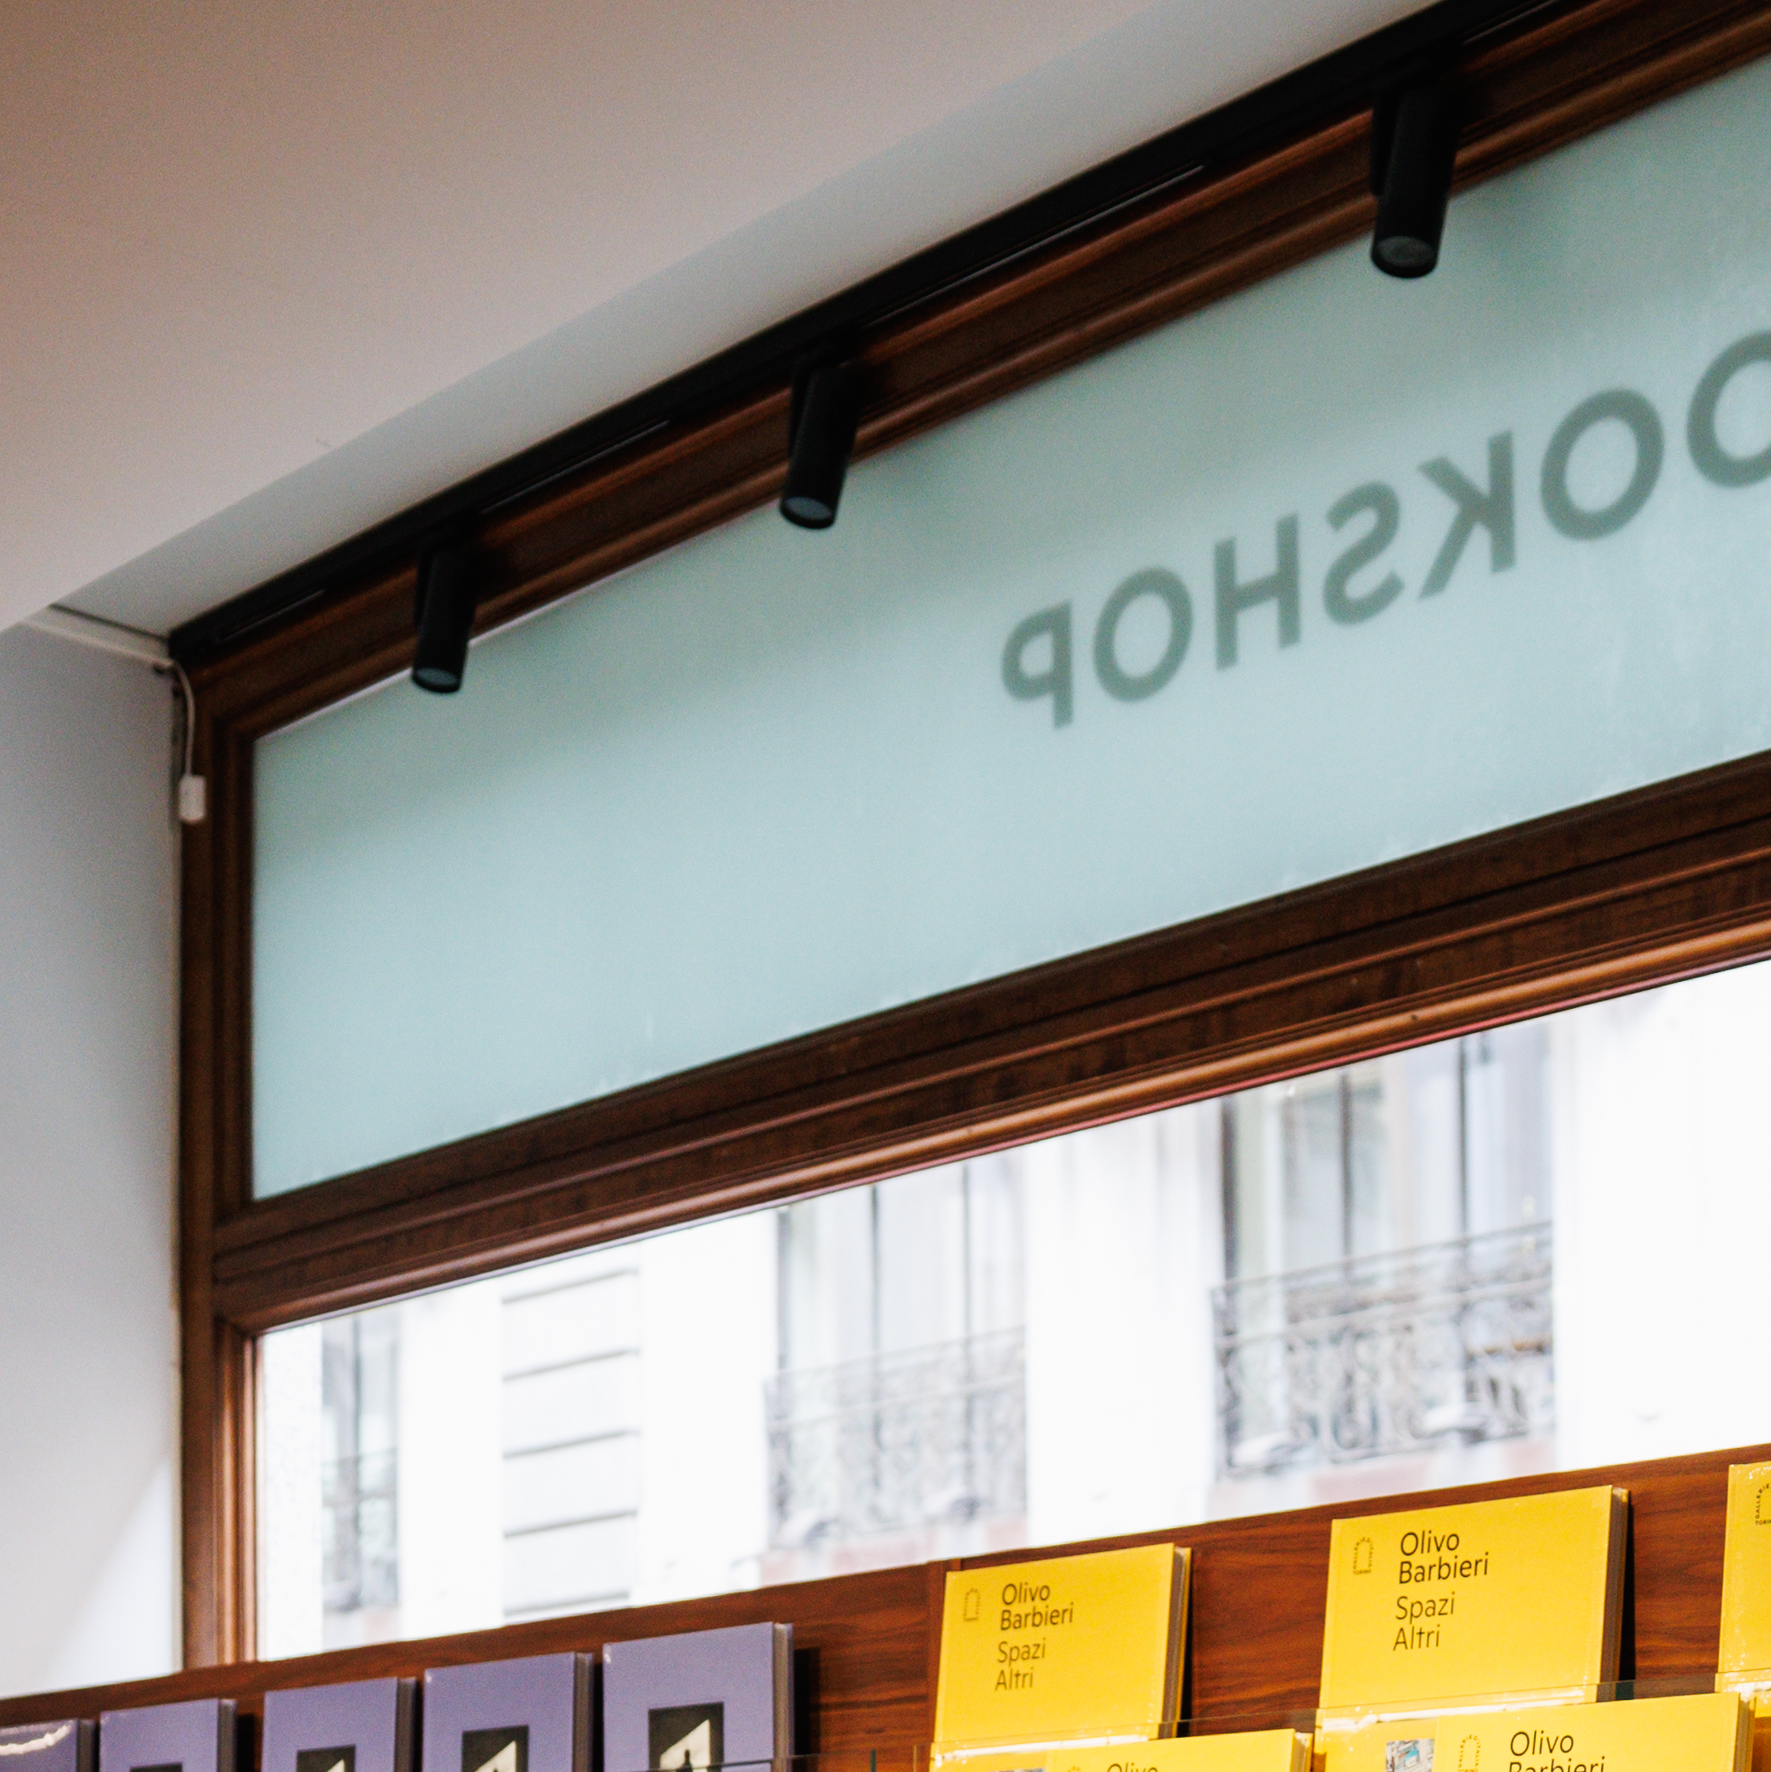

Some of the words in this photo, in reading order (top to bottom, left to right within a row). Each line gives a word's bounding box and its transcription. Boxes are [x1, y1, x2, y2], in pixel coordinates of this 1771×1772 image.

[1400, 1530, 1460, 1557] Olivo
[1398, 1556, 1489, 1585] Barbieri
[1002, 1582, 1051, 1606] Olivo
[1000, 1606, 1073, 1631] Barbieri
[1395, 1595, 1455, 1625] Spazi
[1393, 1625, 1440, 1651] Altri
[997, 1638, 1046, 1667] Spazi
[995, 1666, 1034, 1691] Altri
[1510, 1729, 1574, 1757] Olivo
